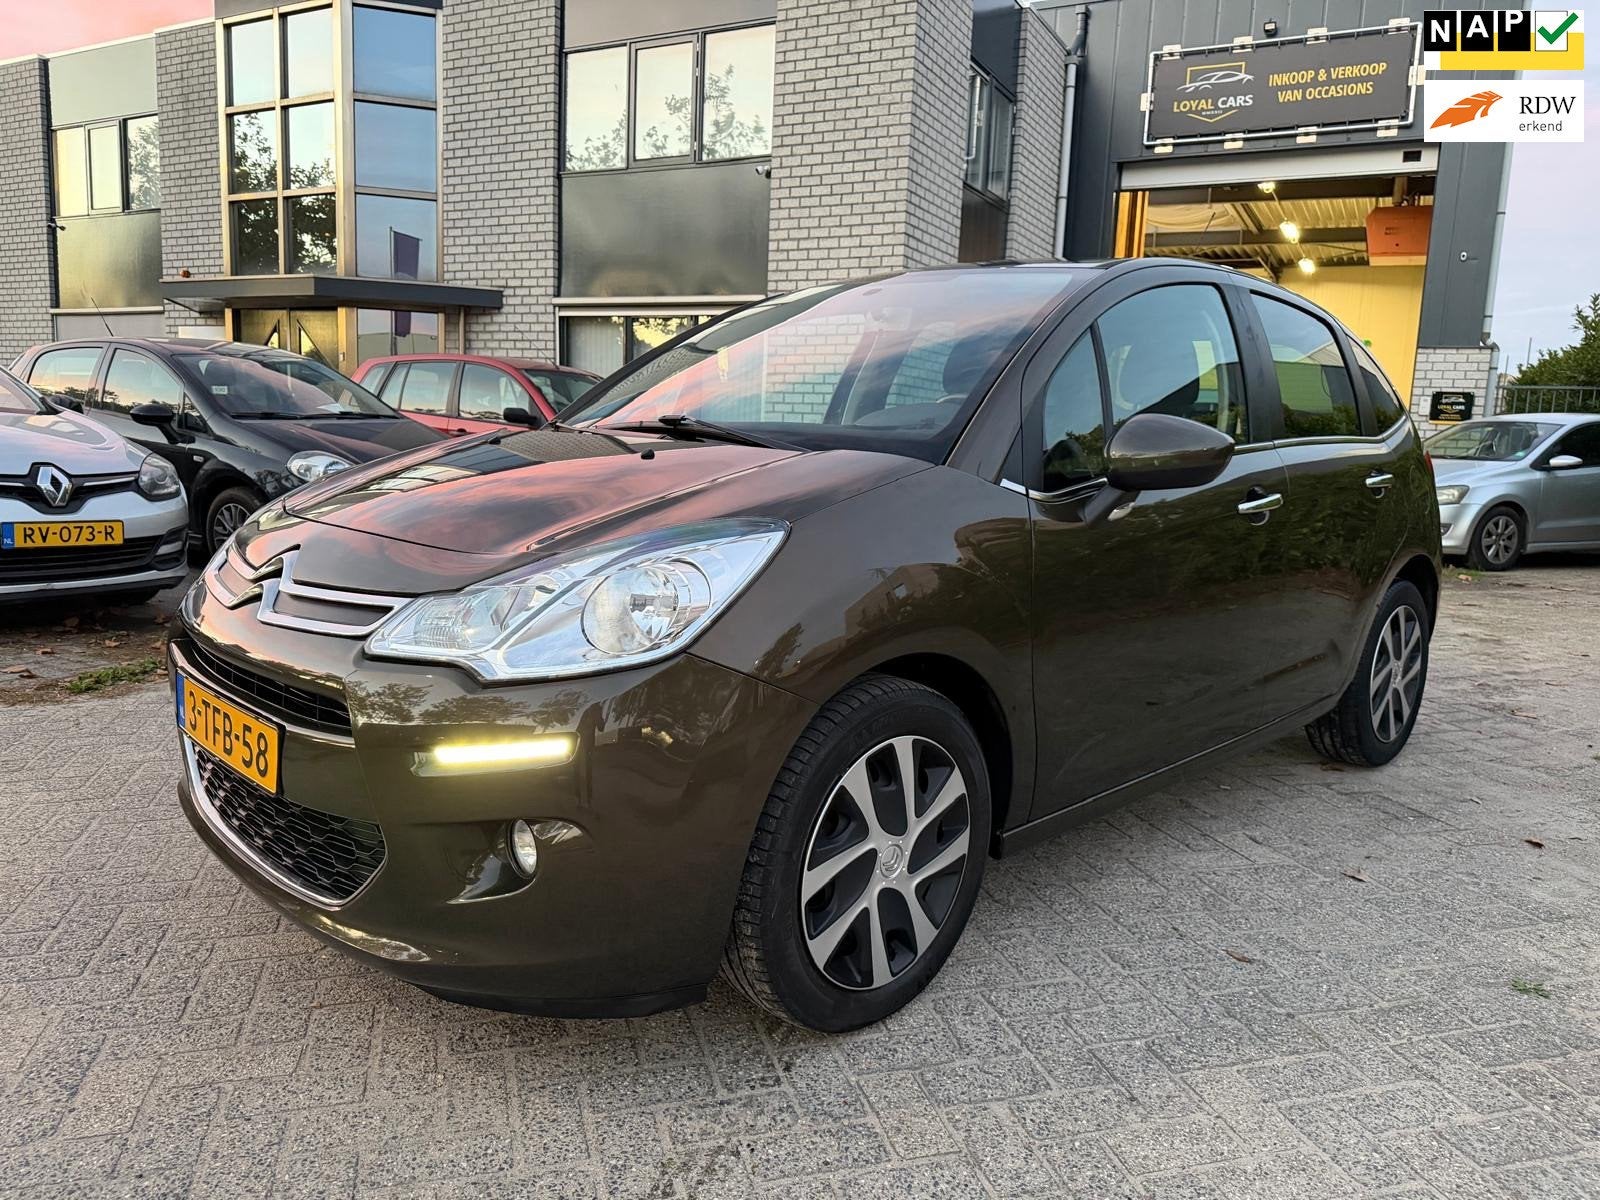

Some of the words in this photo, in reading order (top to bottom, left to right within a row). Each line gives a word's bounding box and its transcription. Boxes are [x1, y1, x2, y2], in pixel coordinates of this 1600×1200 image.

[1268, 69, 1316, 87] INKOOP
[1317, 69, 1327, 81] &
[1329, 62, 1387, 80] VERKOOP
[1277, 90, 1303, 103] VAN
[1306, 82, 1374, 100] OCCASIONS
[1173, 98, 1215, 113] LOYAL
[1217, 94, 1253, 108] CARS
[23, 525, 115, 544] RV-073-R
[189, 690, 269, 778] 3-TFB-58
